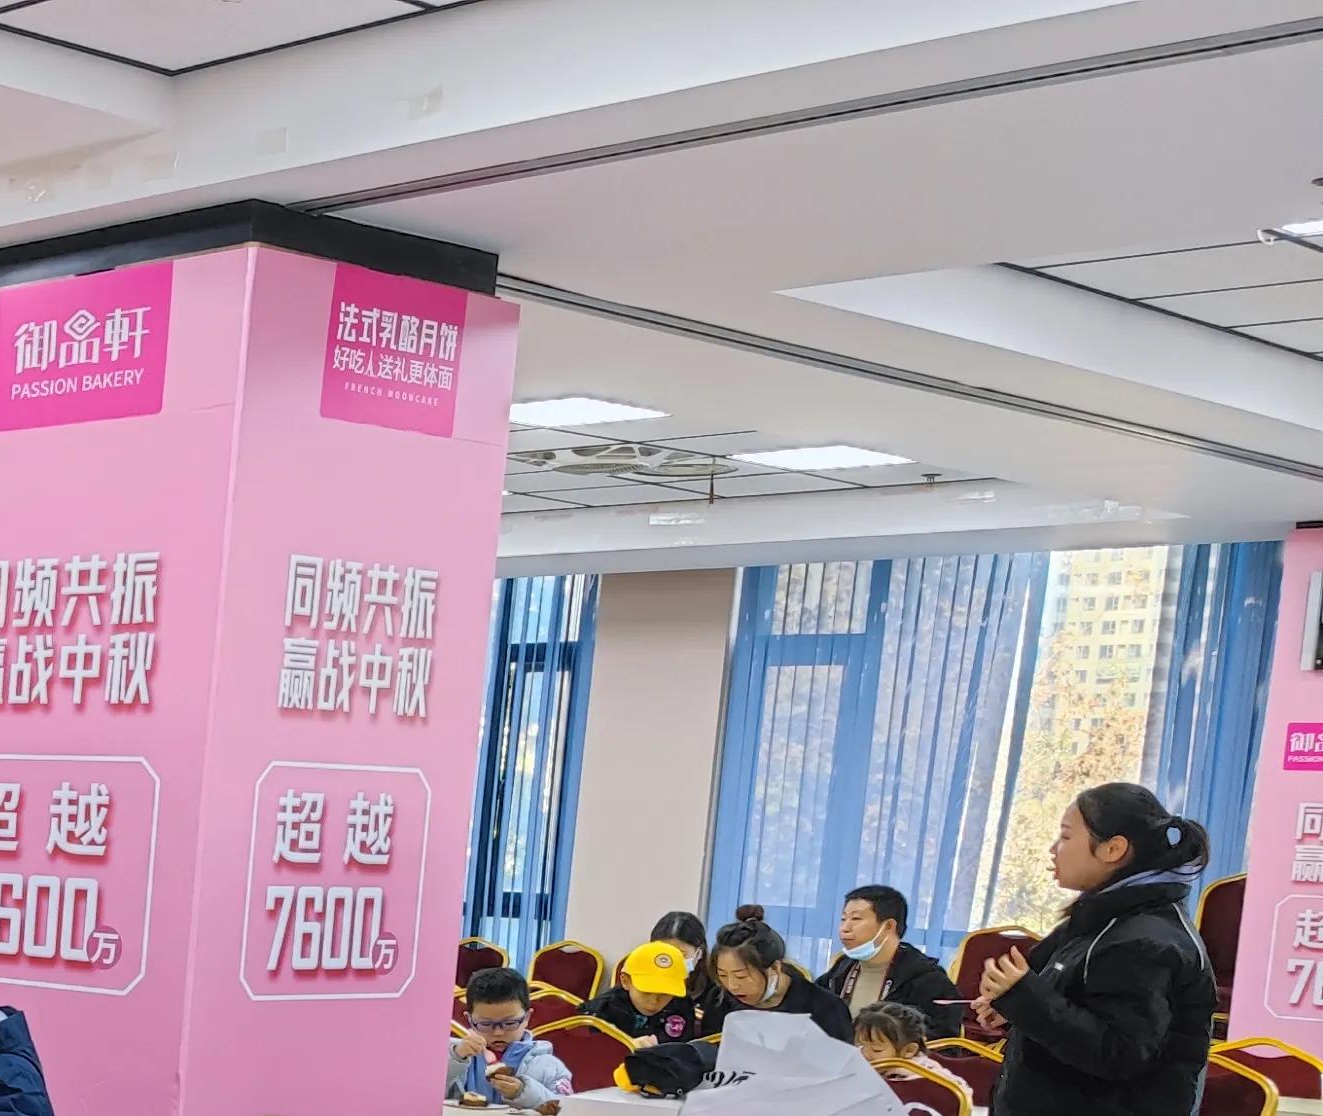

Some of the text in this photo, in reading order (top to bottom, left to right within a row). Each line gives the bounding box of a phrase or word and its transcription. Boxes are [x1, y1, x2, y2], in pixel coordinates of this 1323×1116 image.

[336, 301, 459, 361] 法式乳酪月饼
[10, 368, 145, 400] PASSION BAKERY
[332, 344, 454, 390] 好吃人送礼更体面
[344, 381, 383, 397] FRENCH
[284, 554, 439, 639] 同频共振
[277, 636, 433, 718] 赢战中秋
